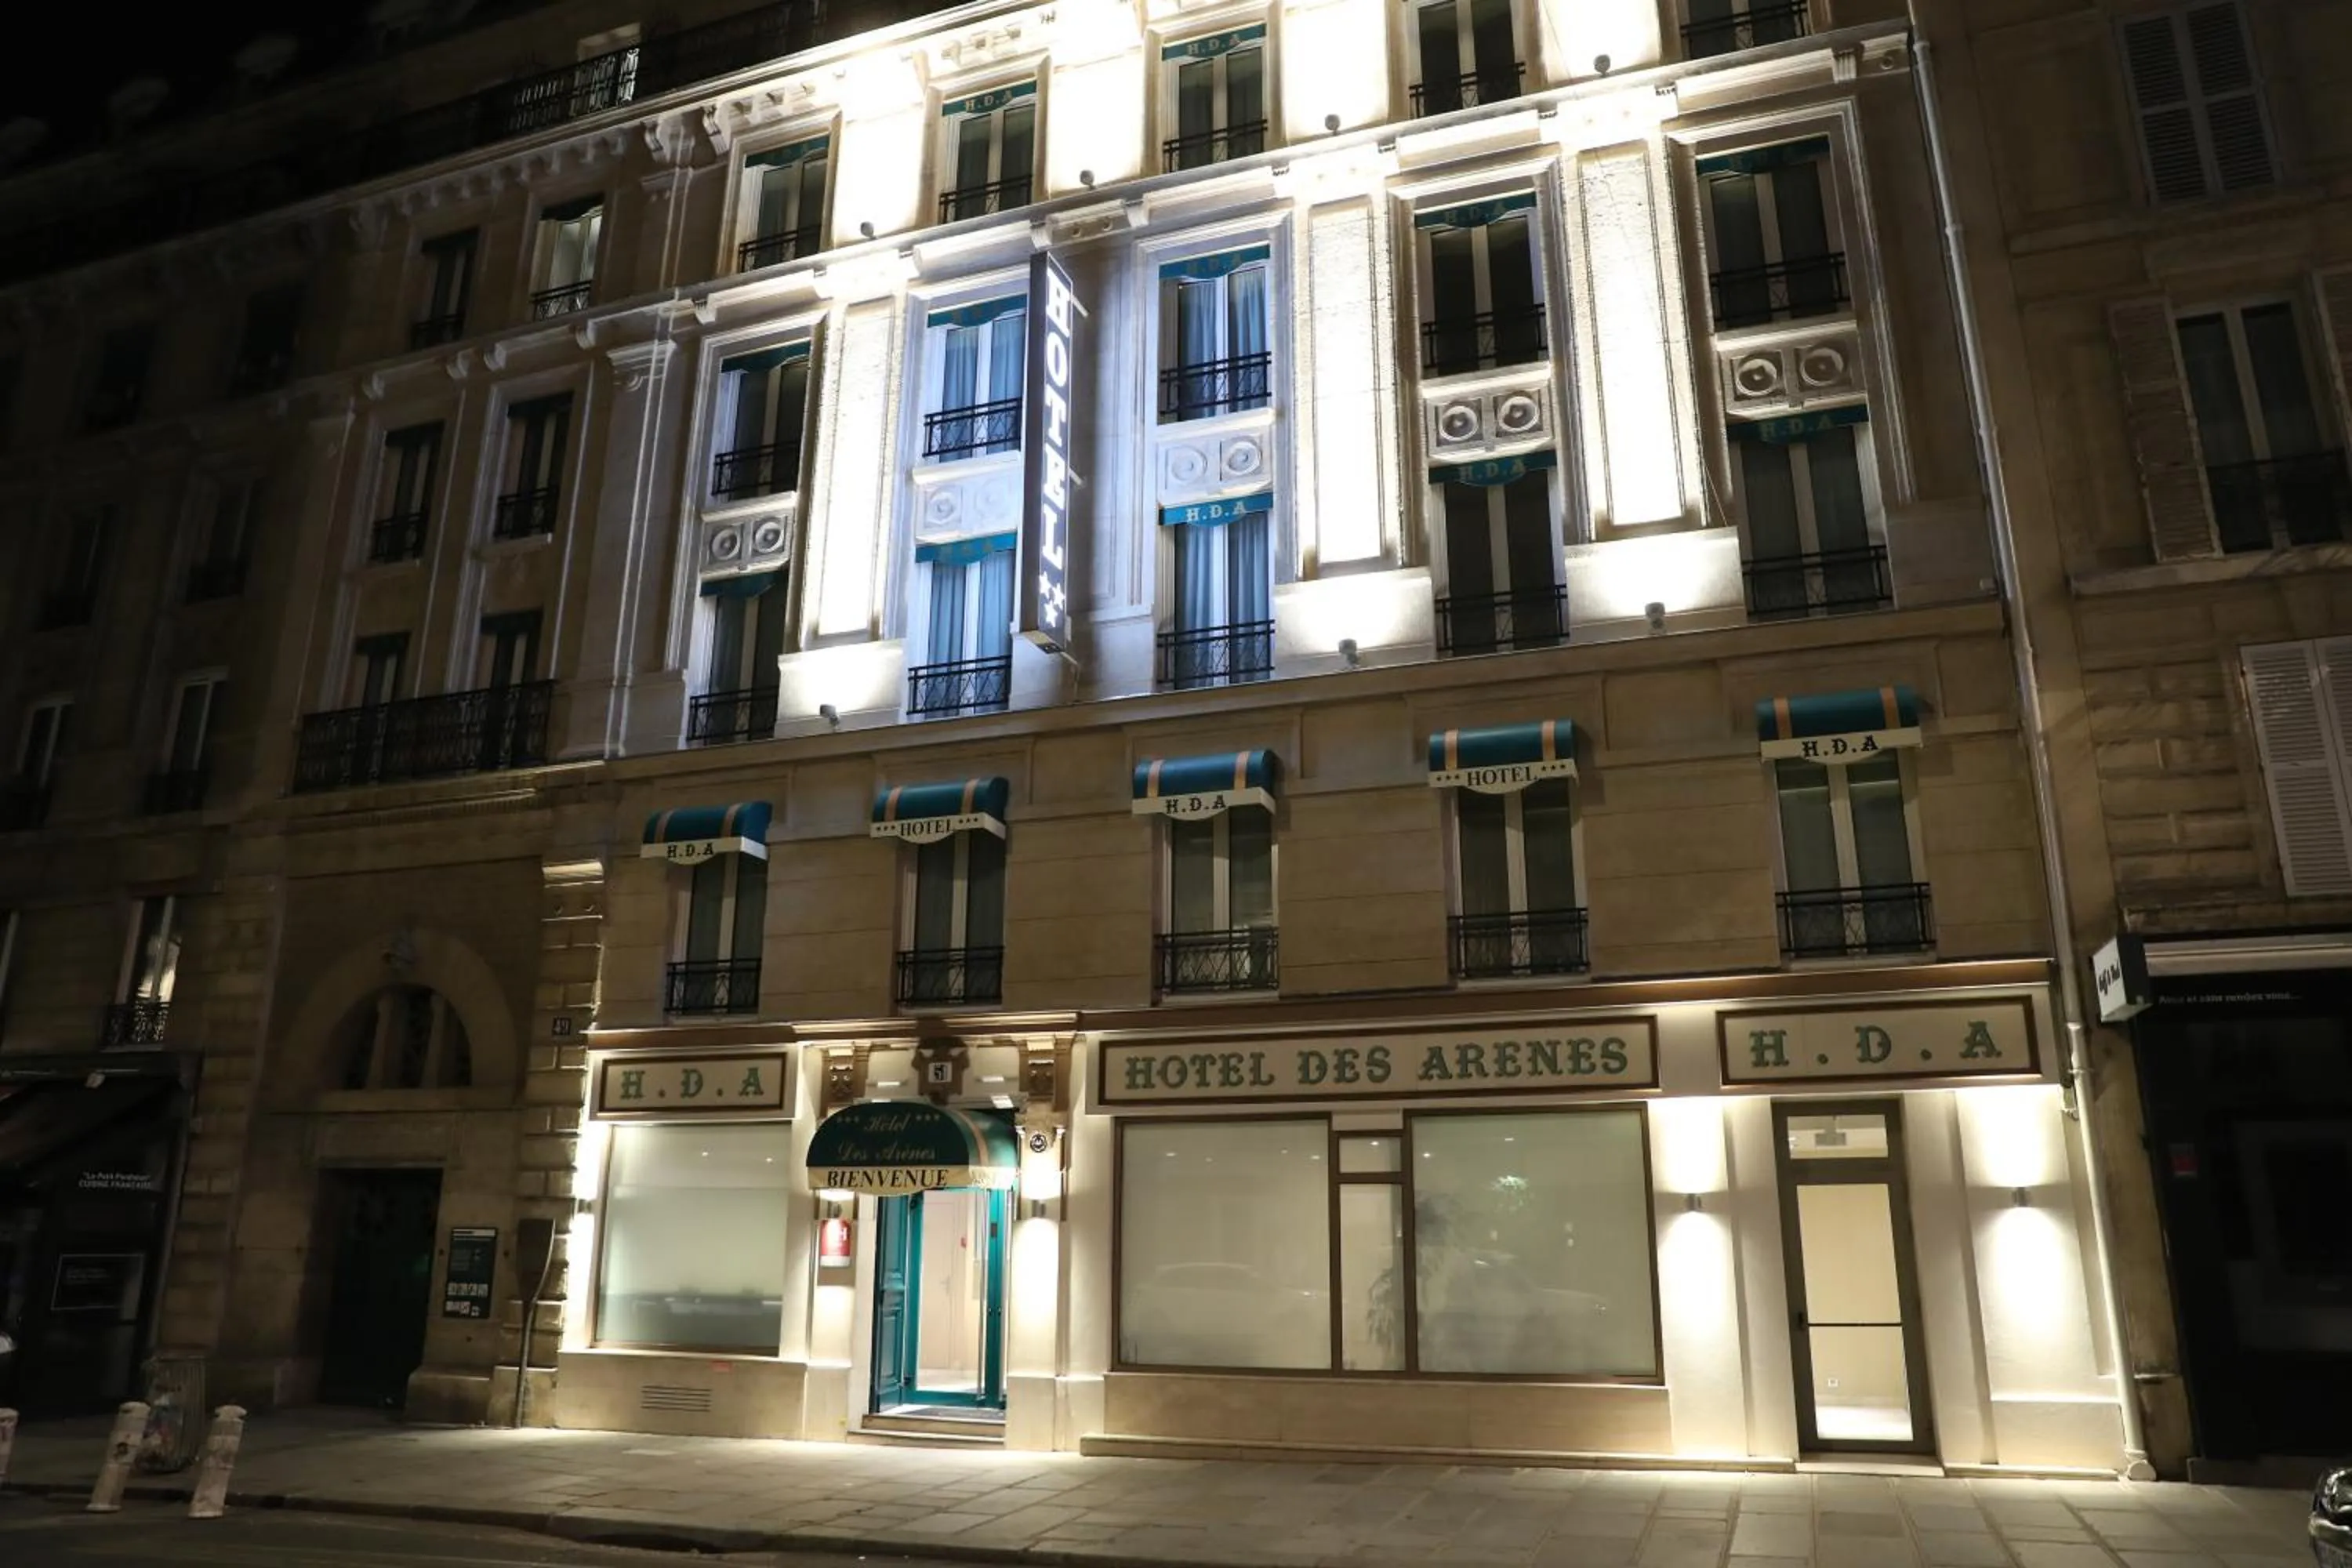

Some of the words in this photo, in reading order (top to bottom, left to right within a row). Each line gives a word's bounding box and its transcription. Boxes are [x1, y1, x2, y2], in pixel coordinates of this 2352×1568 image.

[1043, 270, 1071, 570] HOTEL
[1185, 501, 1247, 523] H.D.A
[1802, 735, 1879, 758] H.D.A
[1466, 765, 1539, 787] HOTEL
[1165, 794, 1227, 815] H.D.A
[900, 818, 953, 837] HOTEL
[666, 842, 714, 859] H.D.A
[1124, 1051, 1275, 1091] HOTEL
[1297, 1046, 1392, 1085] DES
[1417, 1036, 1629, 1082] ARENES
[826, 1168, 949, 1189] BIENVENUE
